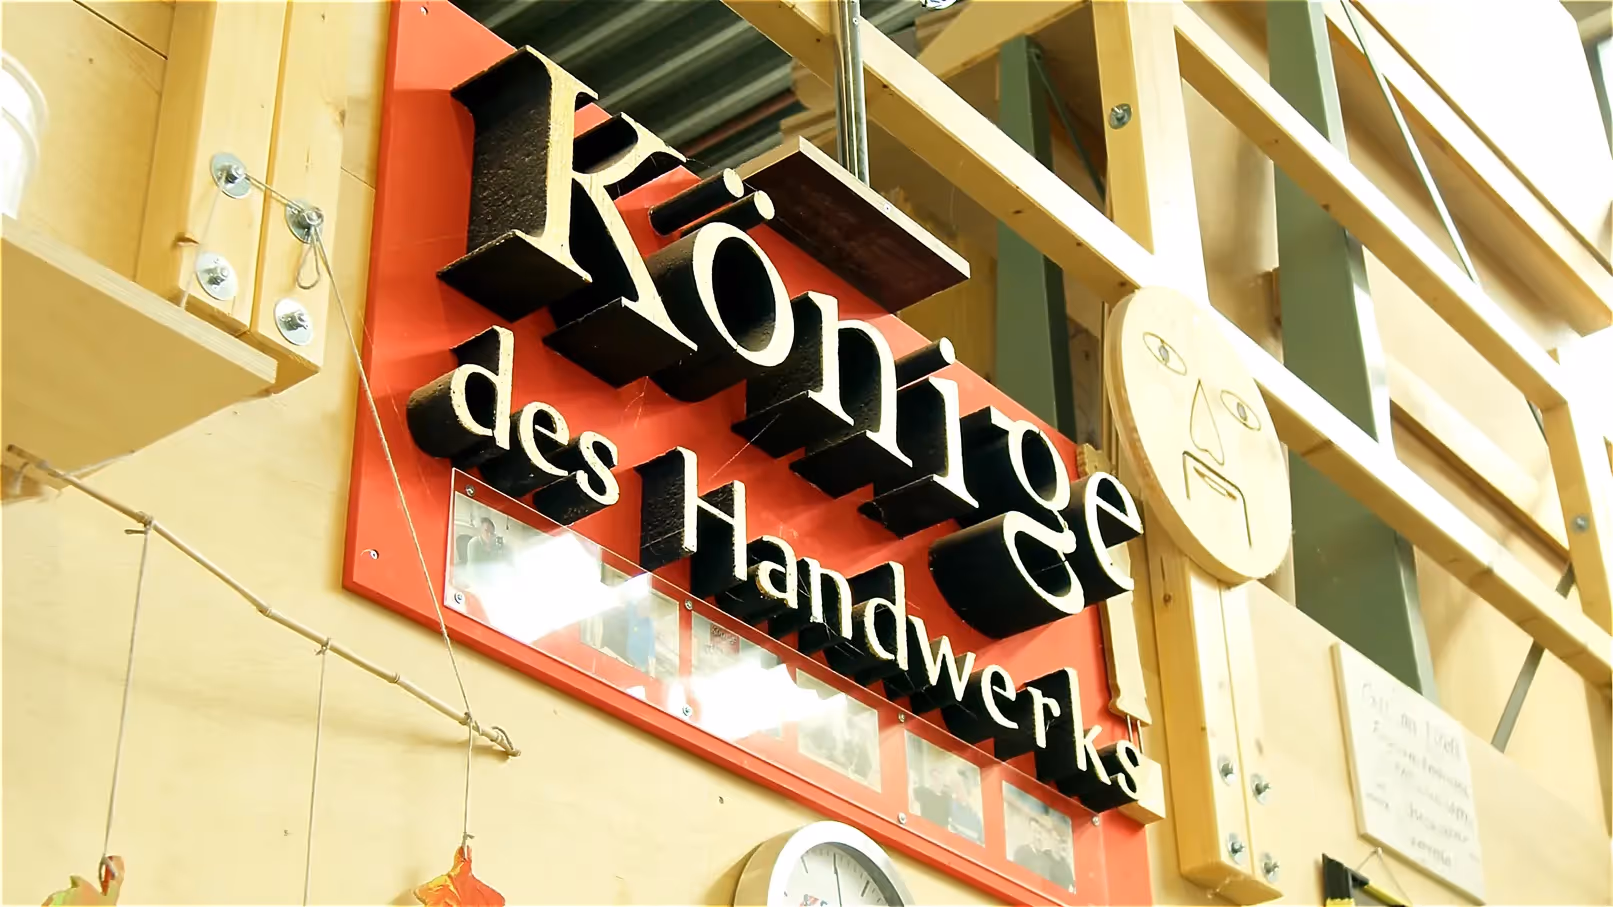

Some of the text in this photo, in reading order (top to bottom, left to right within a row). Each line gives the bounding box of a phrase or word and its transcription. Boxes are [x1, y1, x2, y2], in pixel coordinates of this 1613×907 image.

[450, 325, 1142, 801] des Handwerks
[511, 45, 1144, 614] Könige
